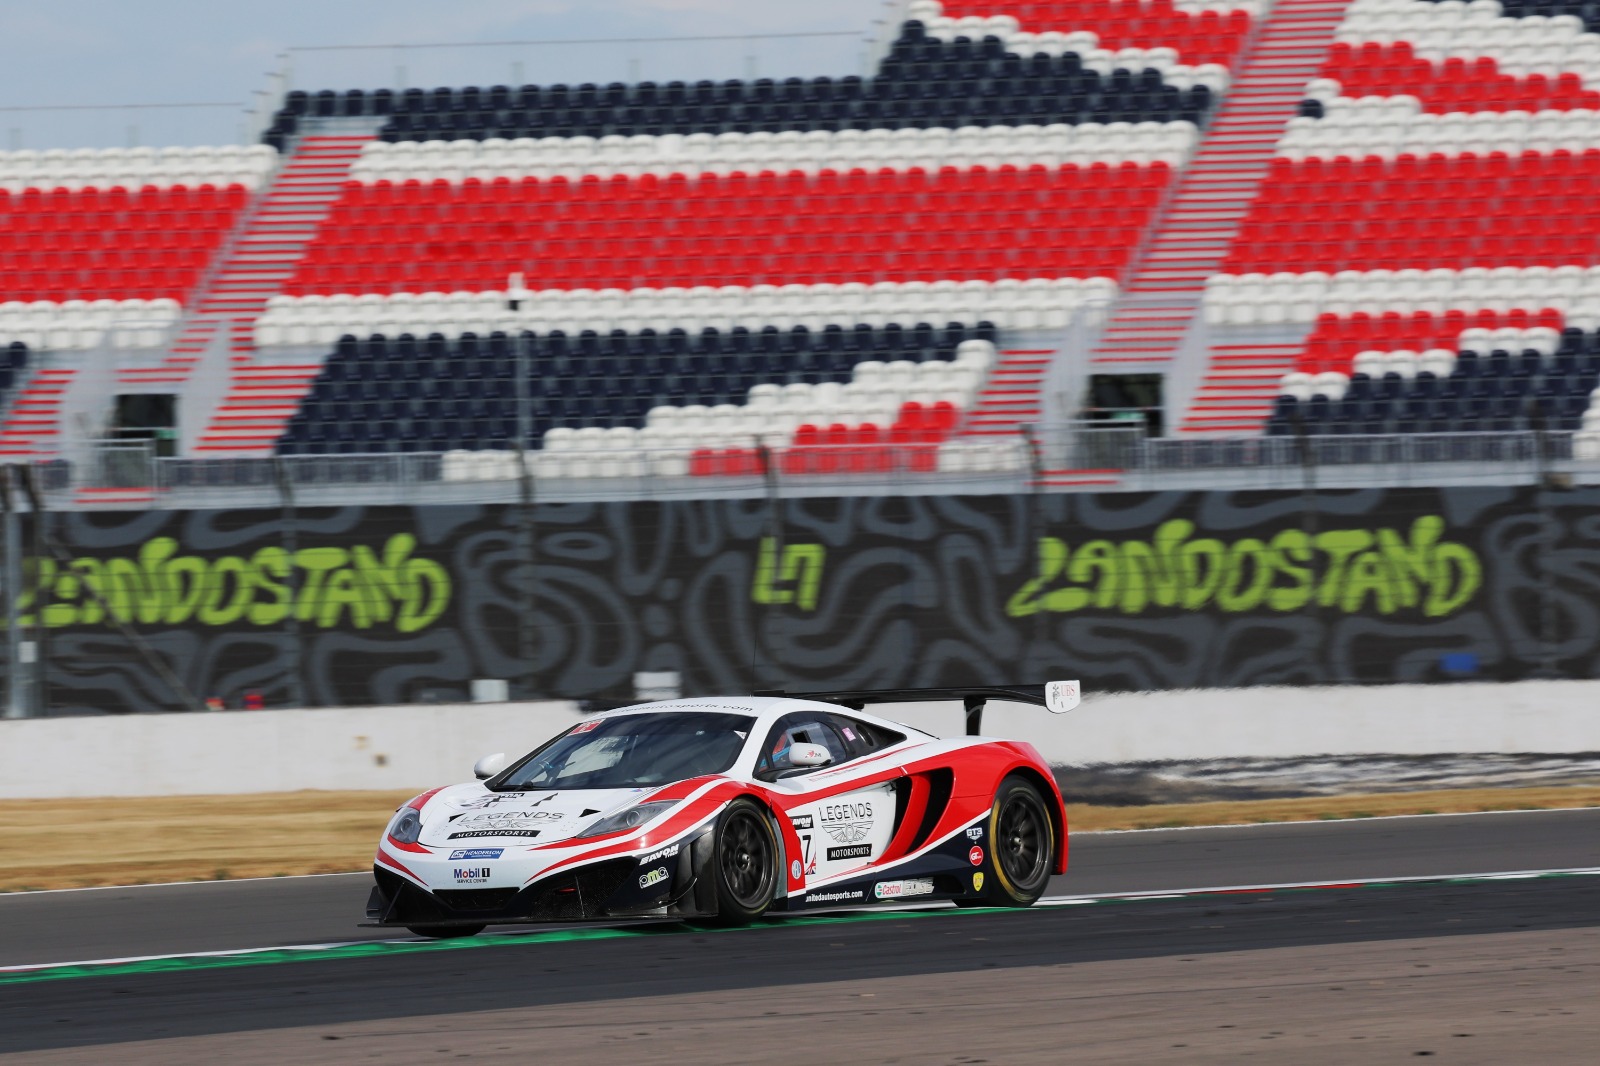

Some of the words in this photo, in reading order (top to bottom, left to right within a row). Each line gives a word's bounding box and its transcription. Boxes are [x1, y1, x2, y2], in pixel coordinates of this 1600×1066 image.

[1007, 515, 1482, 617] LANDOSTAND
[1060, 684, 1075, 697] UBS
[460, 811, 565, 822] LEGENDS
[819, 802, 873, 822] LEGENDS
[456, 830, 533, 838] MOTORSPORTS
[966, 827, 983, 837] GT3
[648, 843, 680, 863] AVON
[830, 846, 870, 859] MOTORSPORTS
[453, 868, 480, 879] Mobil
[882, 884, 902, 896] Castrol
